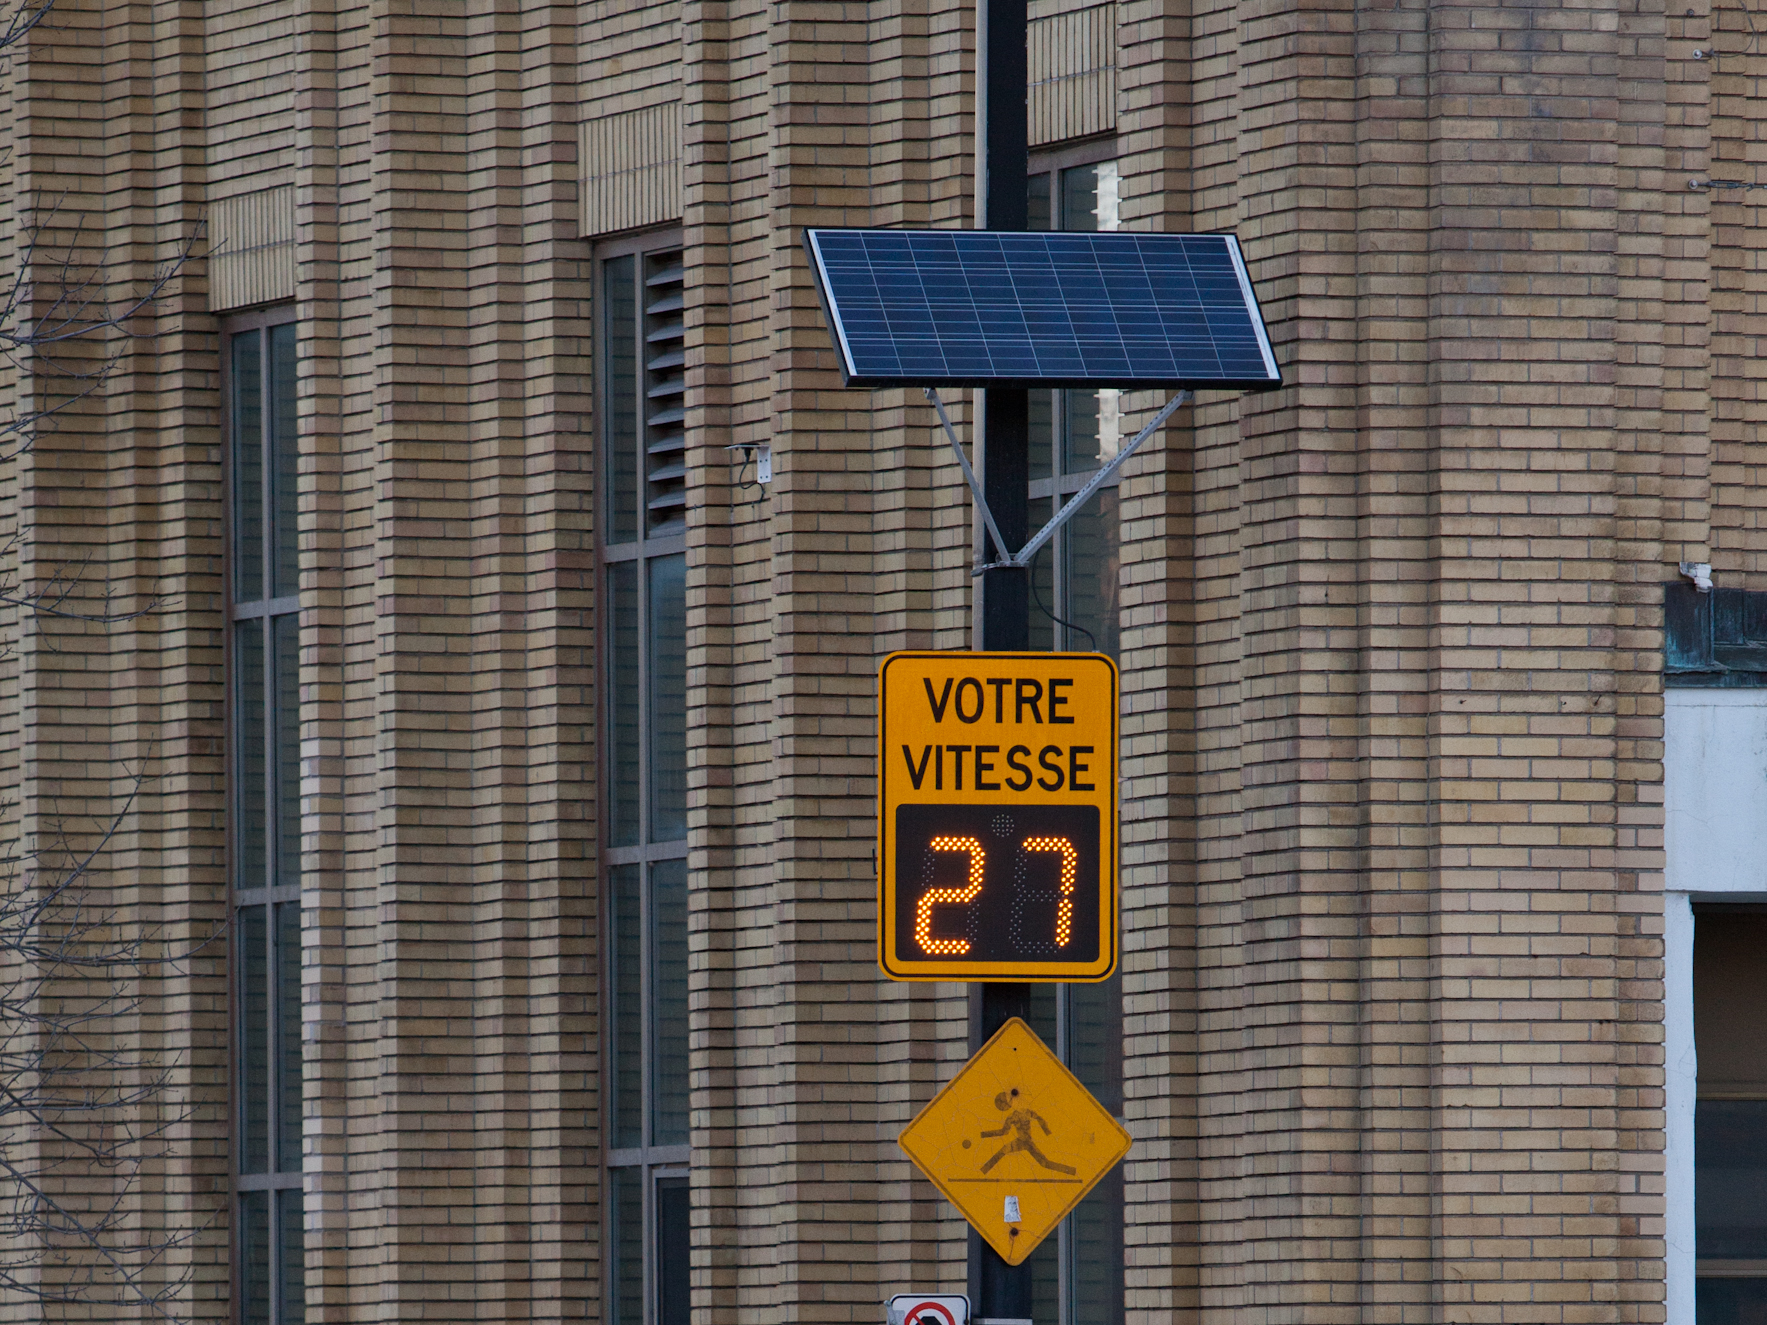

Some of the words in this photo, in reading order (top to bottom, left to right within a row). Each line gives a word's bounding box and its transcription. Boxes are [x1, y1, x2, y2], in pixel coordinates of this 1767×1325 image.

[923, 676, 1075, 725] VOTRE
[901, 744, 1096, 792] VITESSE
[915, 836, 1078, 955] 27
